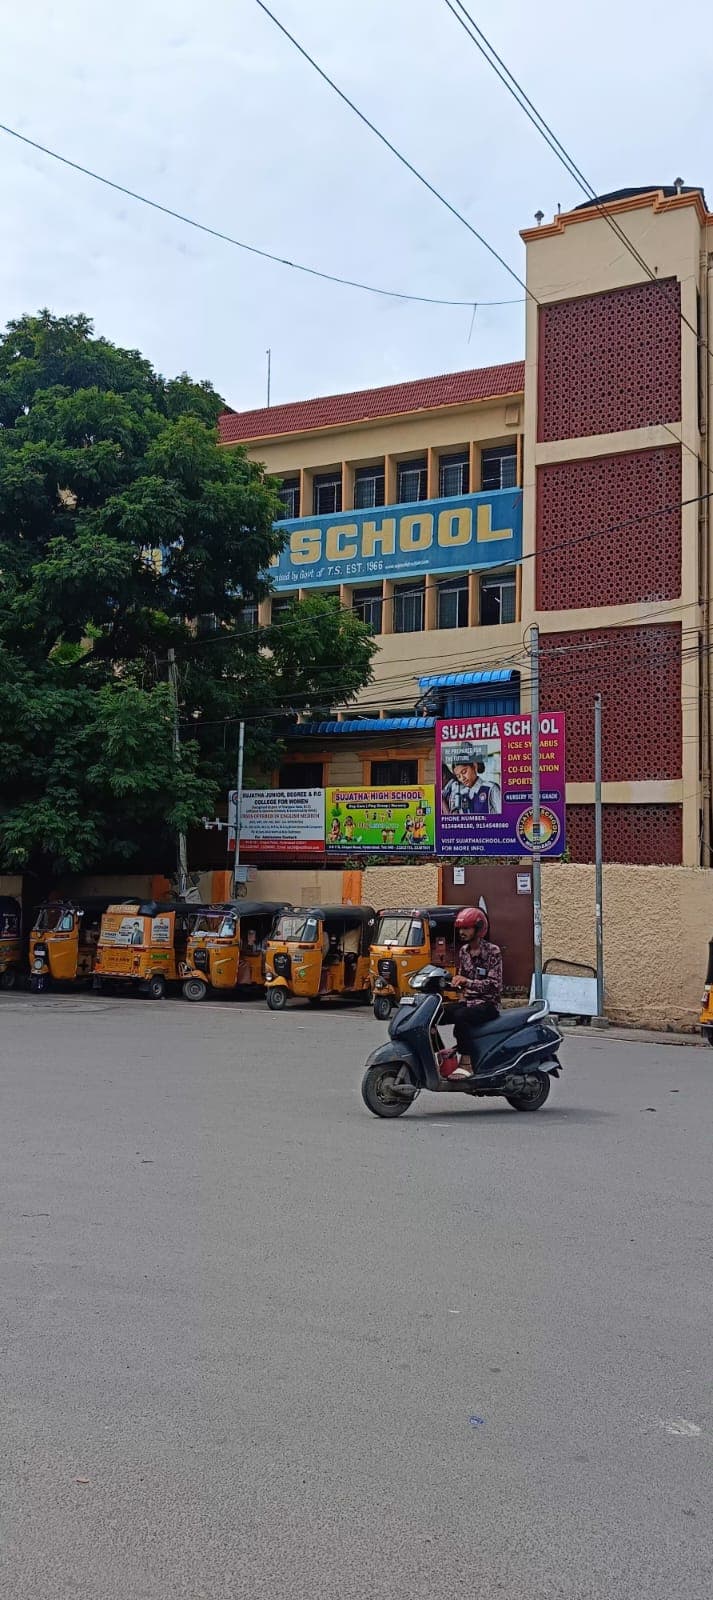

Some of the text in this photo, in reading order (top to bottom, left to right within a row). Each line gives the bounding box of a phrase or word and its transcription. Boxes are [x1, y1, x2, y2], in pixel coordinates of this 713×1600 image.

[289, 503, 513, 566] SCHOOL
[327, 565, 343, 576] T.S.
[366, 560, 384, 572] 1966
[441, 718, 559, 740] SUJATHA SCHOL
[507, 739, 559, 749] ICSE SYABUS
[507, 752, 556, 761] DAY SCOLAR
[336, 791, 422, 800] SUJATHA HIGH SCHOOL
